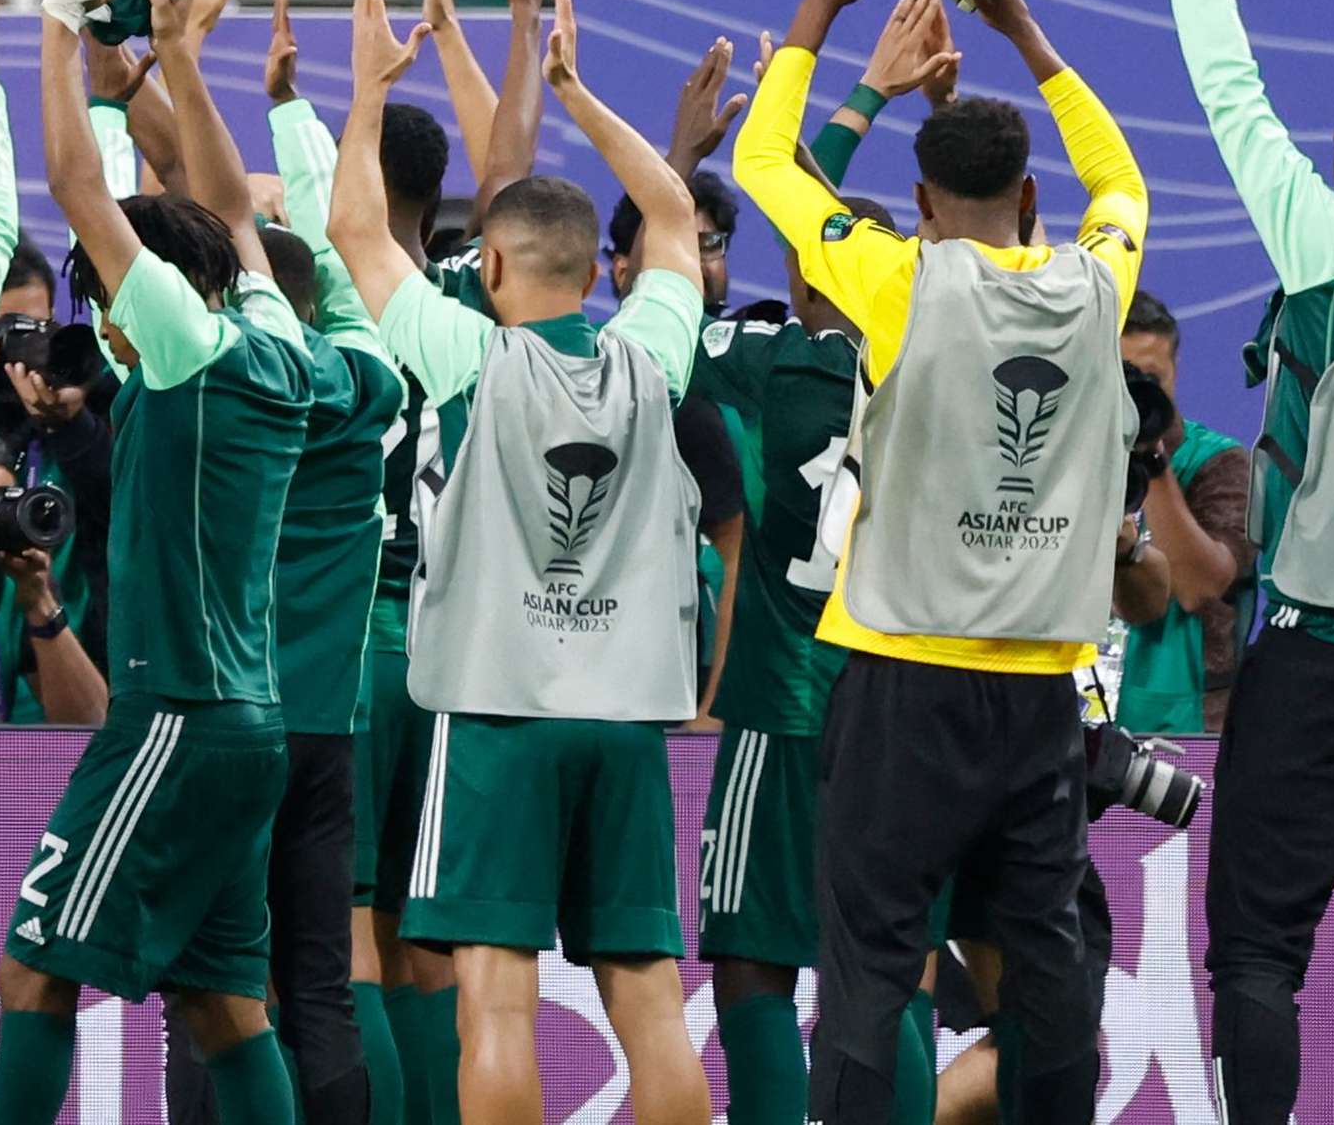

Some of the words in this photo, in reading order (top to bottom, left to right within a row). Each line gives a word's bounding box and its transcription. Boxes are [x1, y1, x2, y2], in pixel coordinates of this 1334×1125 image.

[998, 500, 1028, 514] AFC
[957, 511, 1020, 533] ASIAN
[1024, 517, 1069, 534] CUP
[961, 531, 1014, 549] QATAR
[546, 582, 578, 596] AFC
[523, 591, 572, 615] ASIAN
[576, 598, 618, 616] CUP
[527, 611, 565, 631] QATAR
[19, 831, 69, 908] 2
